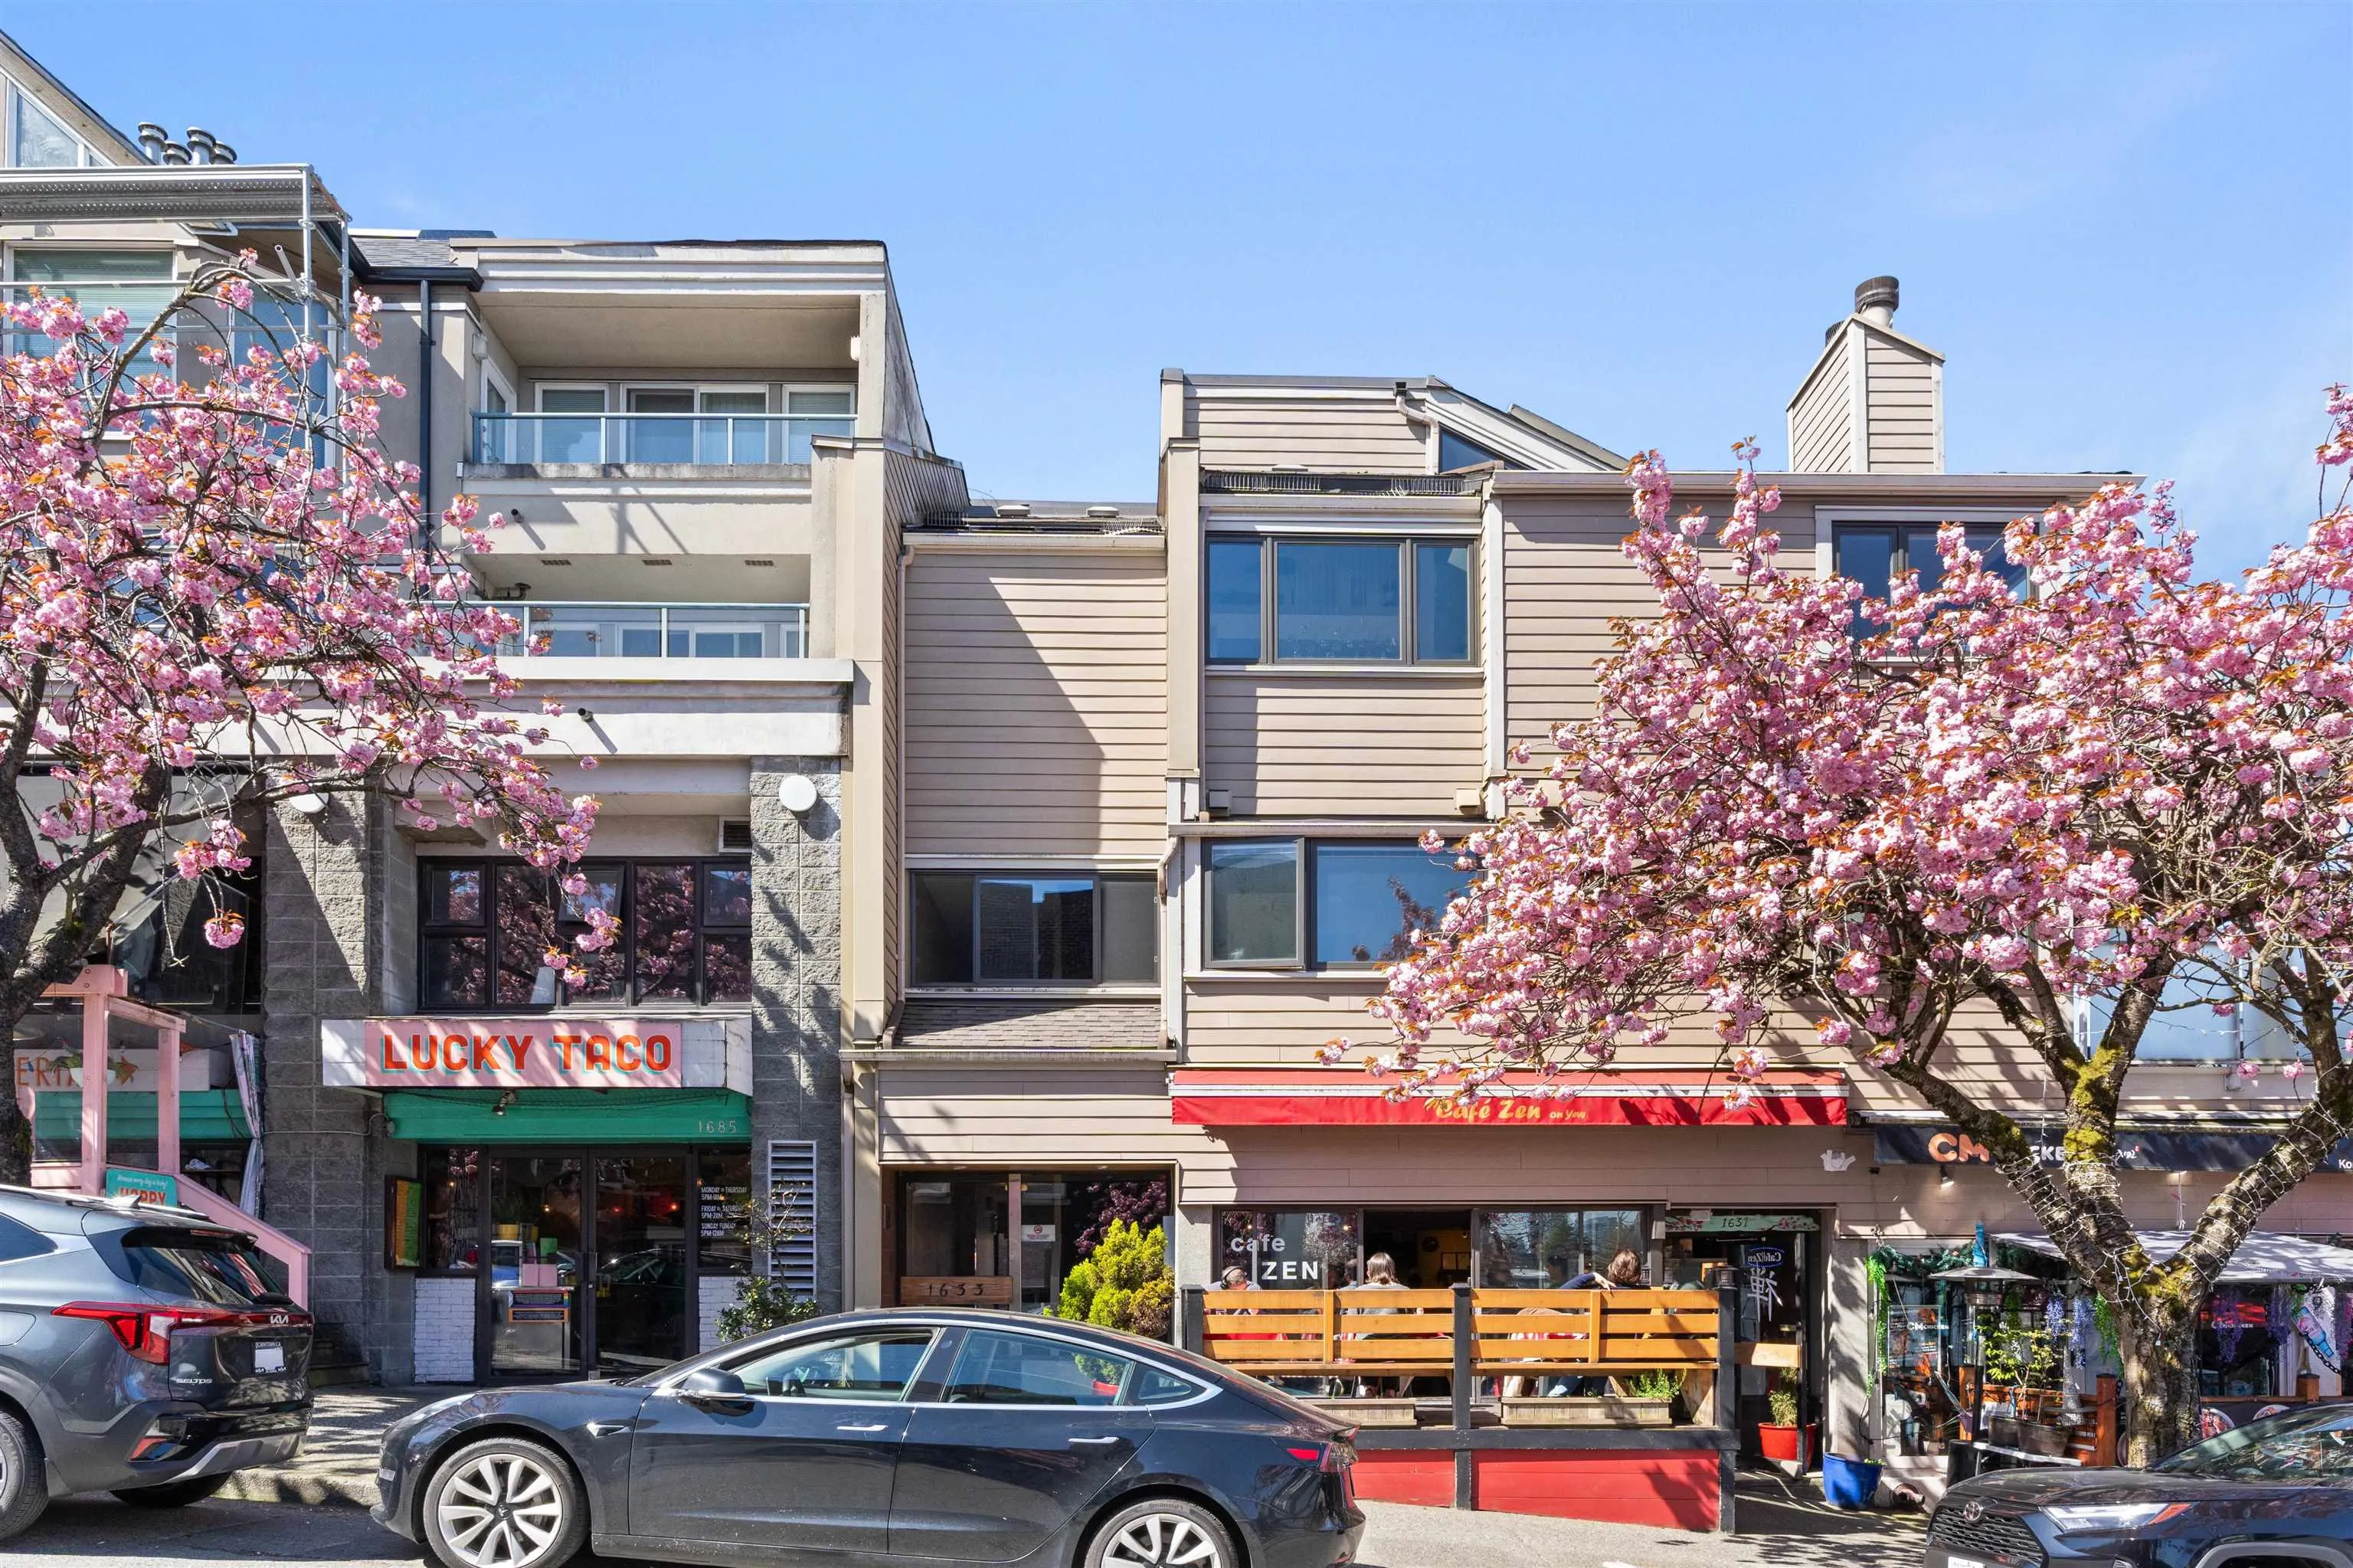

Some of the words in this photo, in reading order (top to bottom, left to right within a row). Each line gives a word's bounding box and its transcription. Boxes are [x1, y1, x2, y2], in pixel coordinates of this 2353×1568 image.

[381, 1034, 534, 1073] LUCKY
[551, 1034, 673, 1073] TACO
[1497, 1099, 1542, 1120] Zen
[698, 1120, 737, 1134] 1685
[1928, 1132, 1991, 1162] CM
[2338, 1158, 2353, 1169] Ko
[1230, 1233, 1286, 1252] cafe
[1261, 1261, 1318, 1280] ZEN
[926, 1282, 984, 1298] 1633
